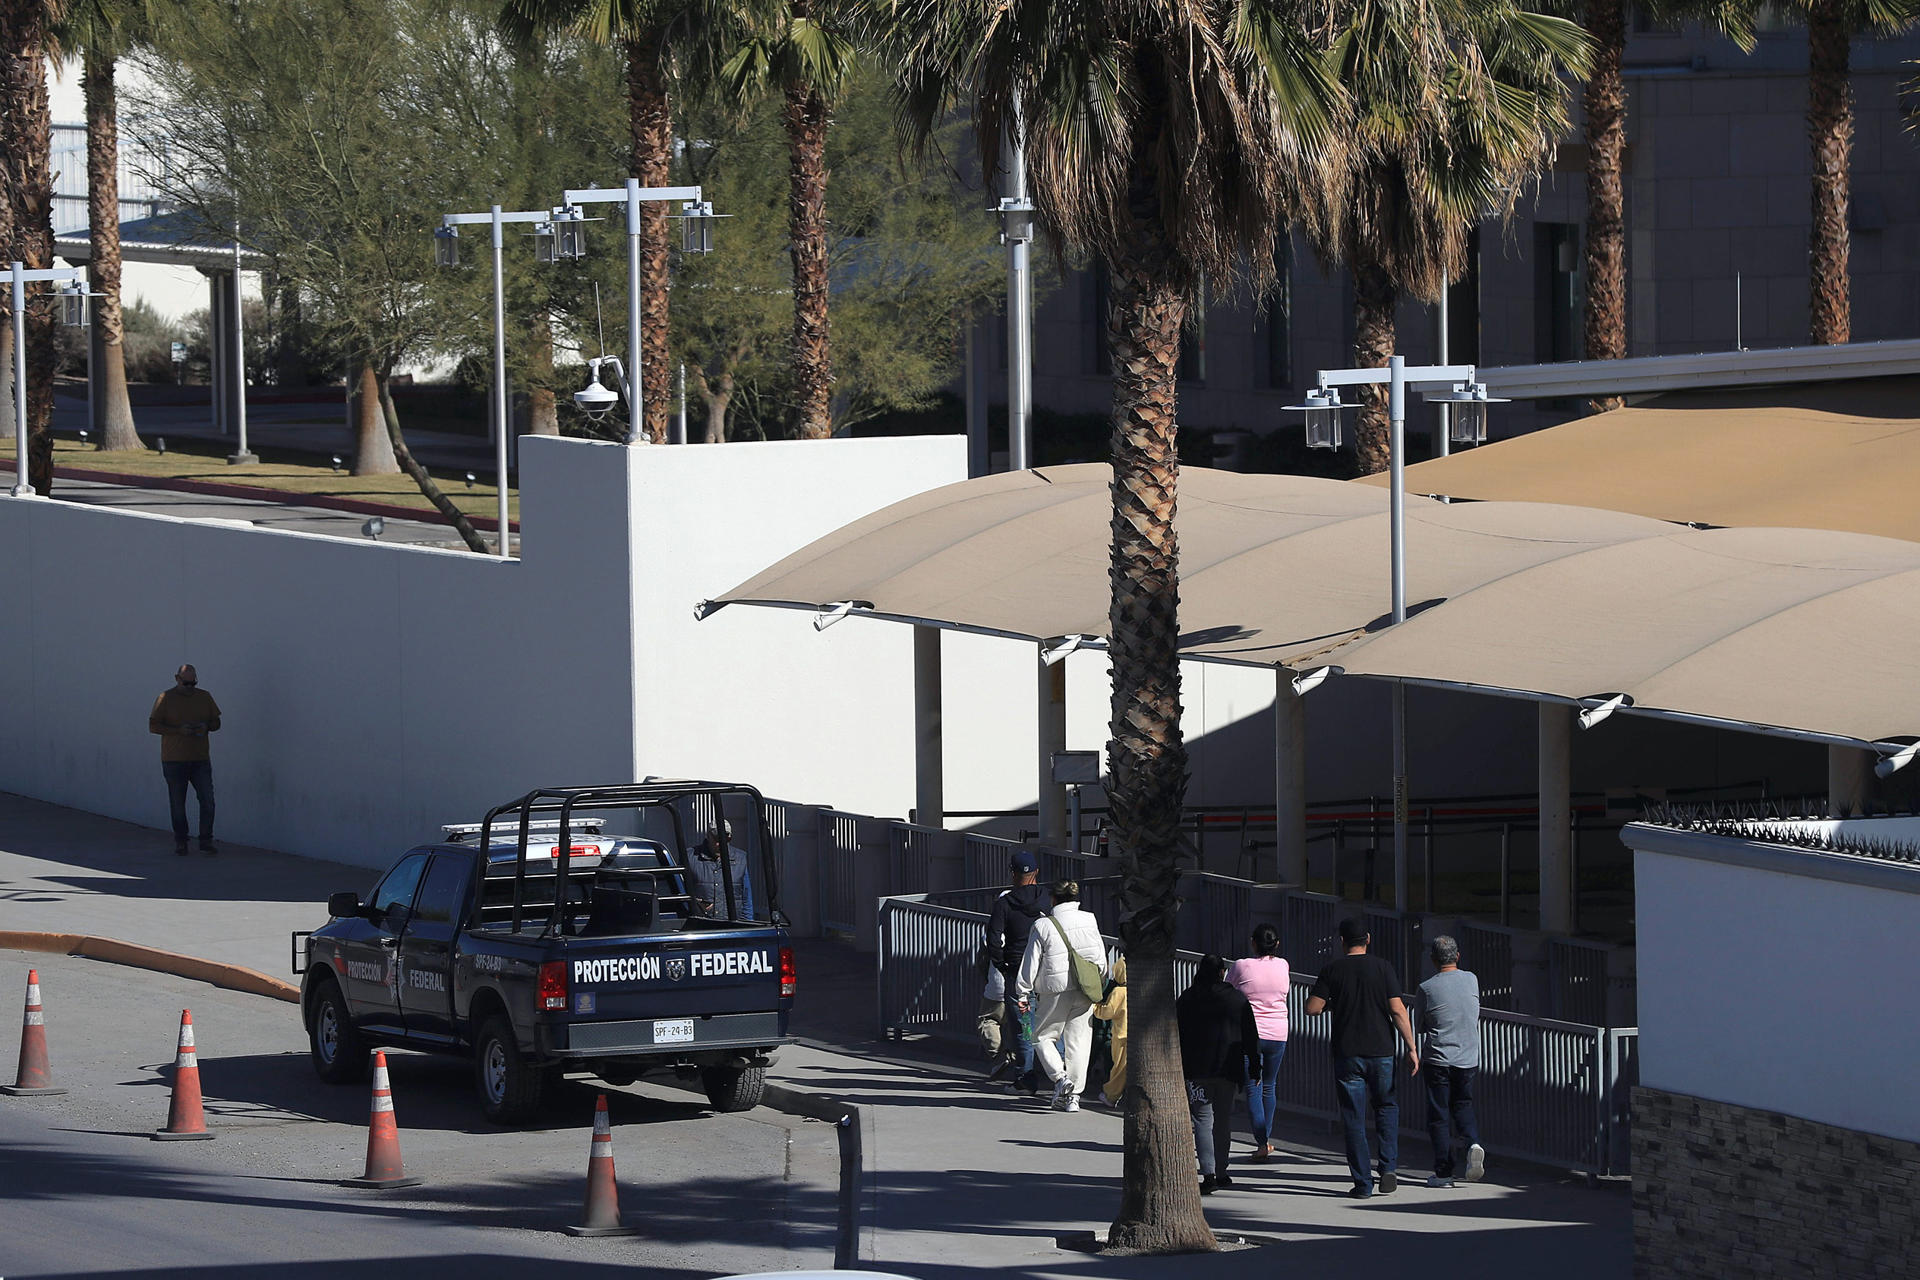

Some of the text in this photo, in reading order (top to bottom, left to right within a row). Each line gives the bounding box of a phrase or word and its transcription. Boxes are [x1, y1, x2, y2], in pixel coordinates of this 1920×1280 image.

[347, 959, 445, 992] PROTECCIÓN FEDERAL
[574, 950, 773, 983] PROTECCIÓN FEDERAL
[655, 1025, 692, 1037] SPF-24-B3
